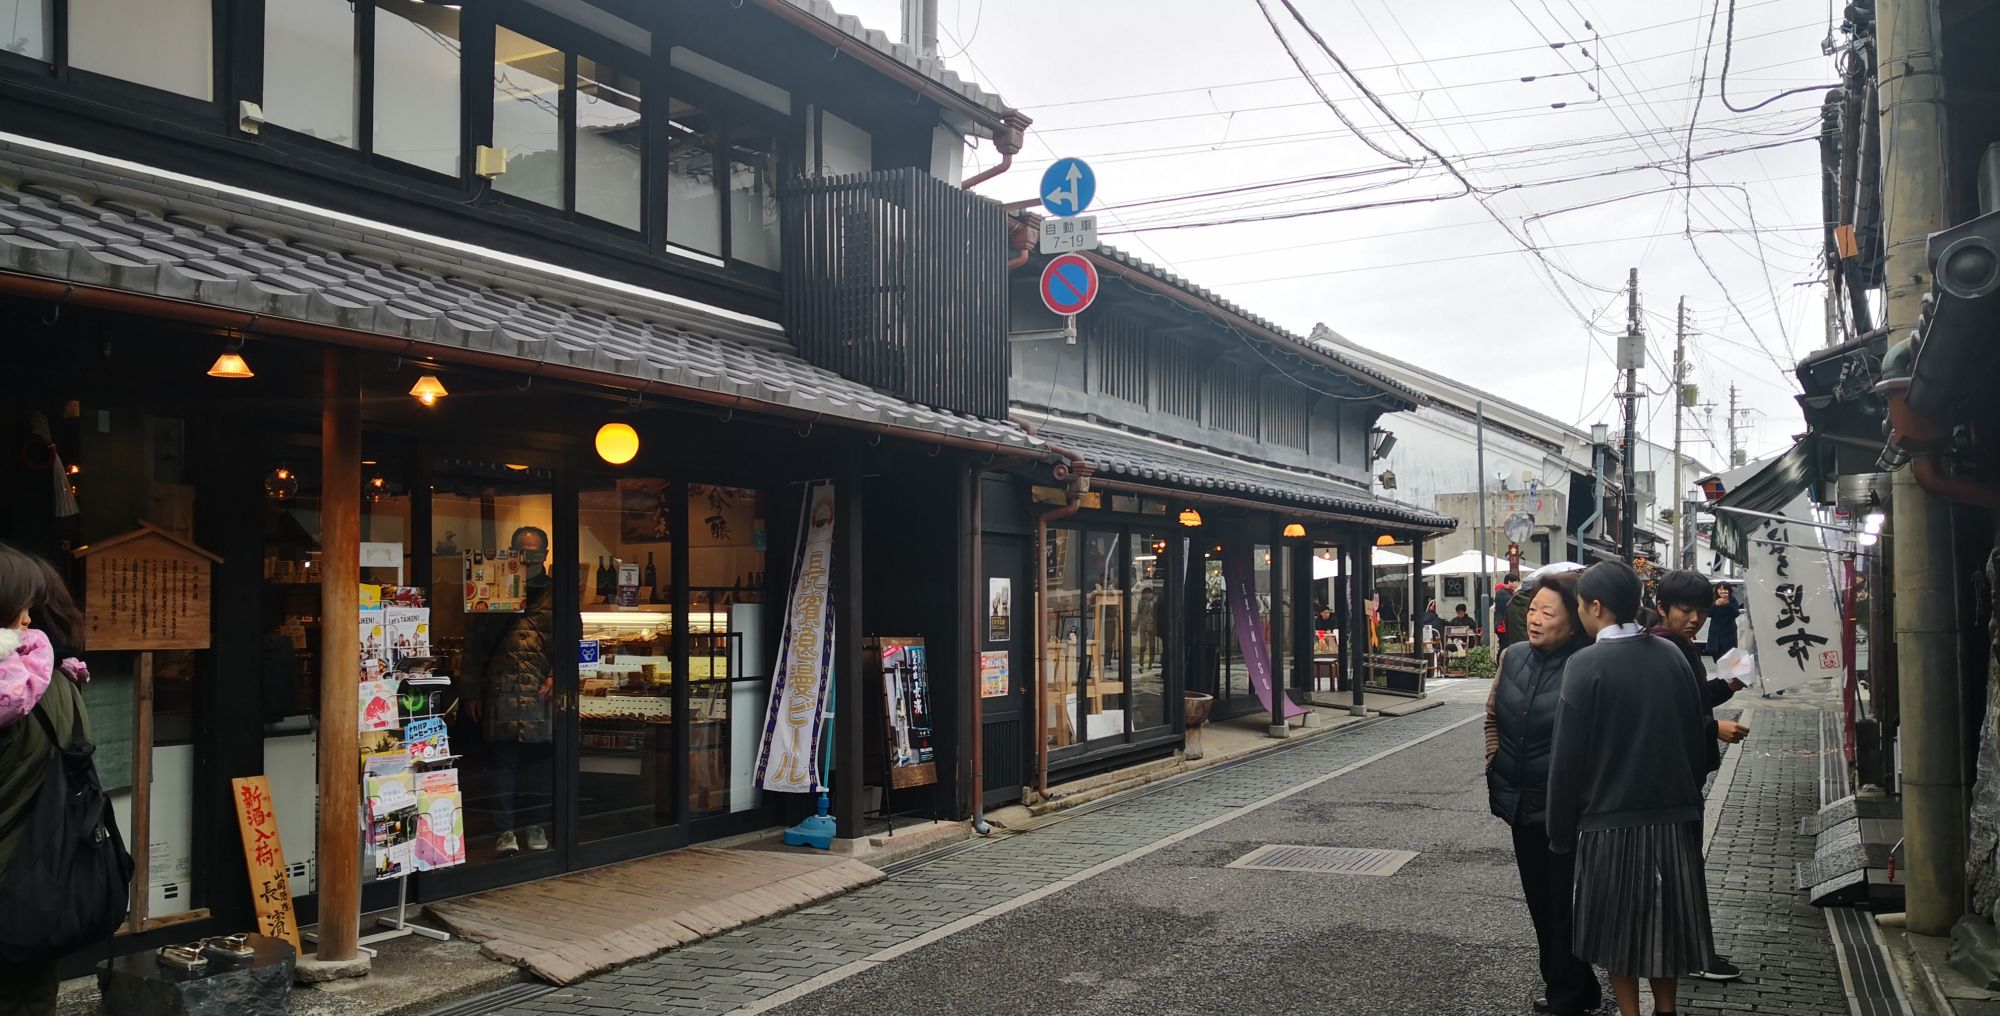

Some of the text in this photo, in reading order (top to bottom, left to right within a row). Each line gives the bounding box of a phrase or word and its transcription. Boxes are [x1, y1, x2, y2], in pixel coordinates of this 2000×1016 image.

[1045, 220, 1091, 235] 自動車
[1054, 235, 1084, 249] 7-19
[756, 731, 773, 780] BEER
[241, 785, 275, 867] 新酒入荷
